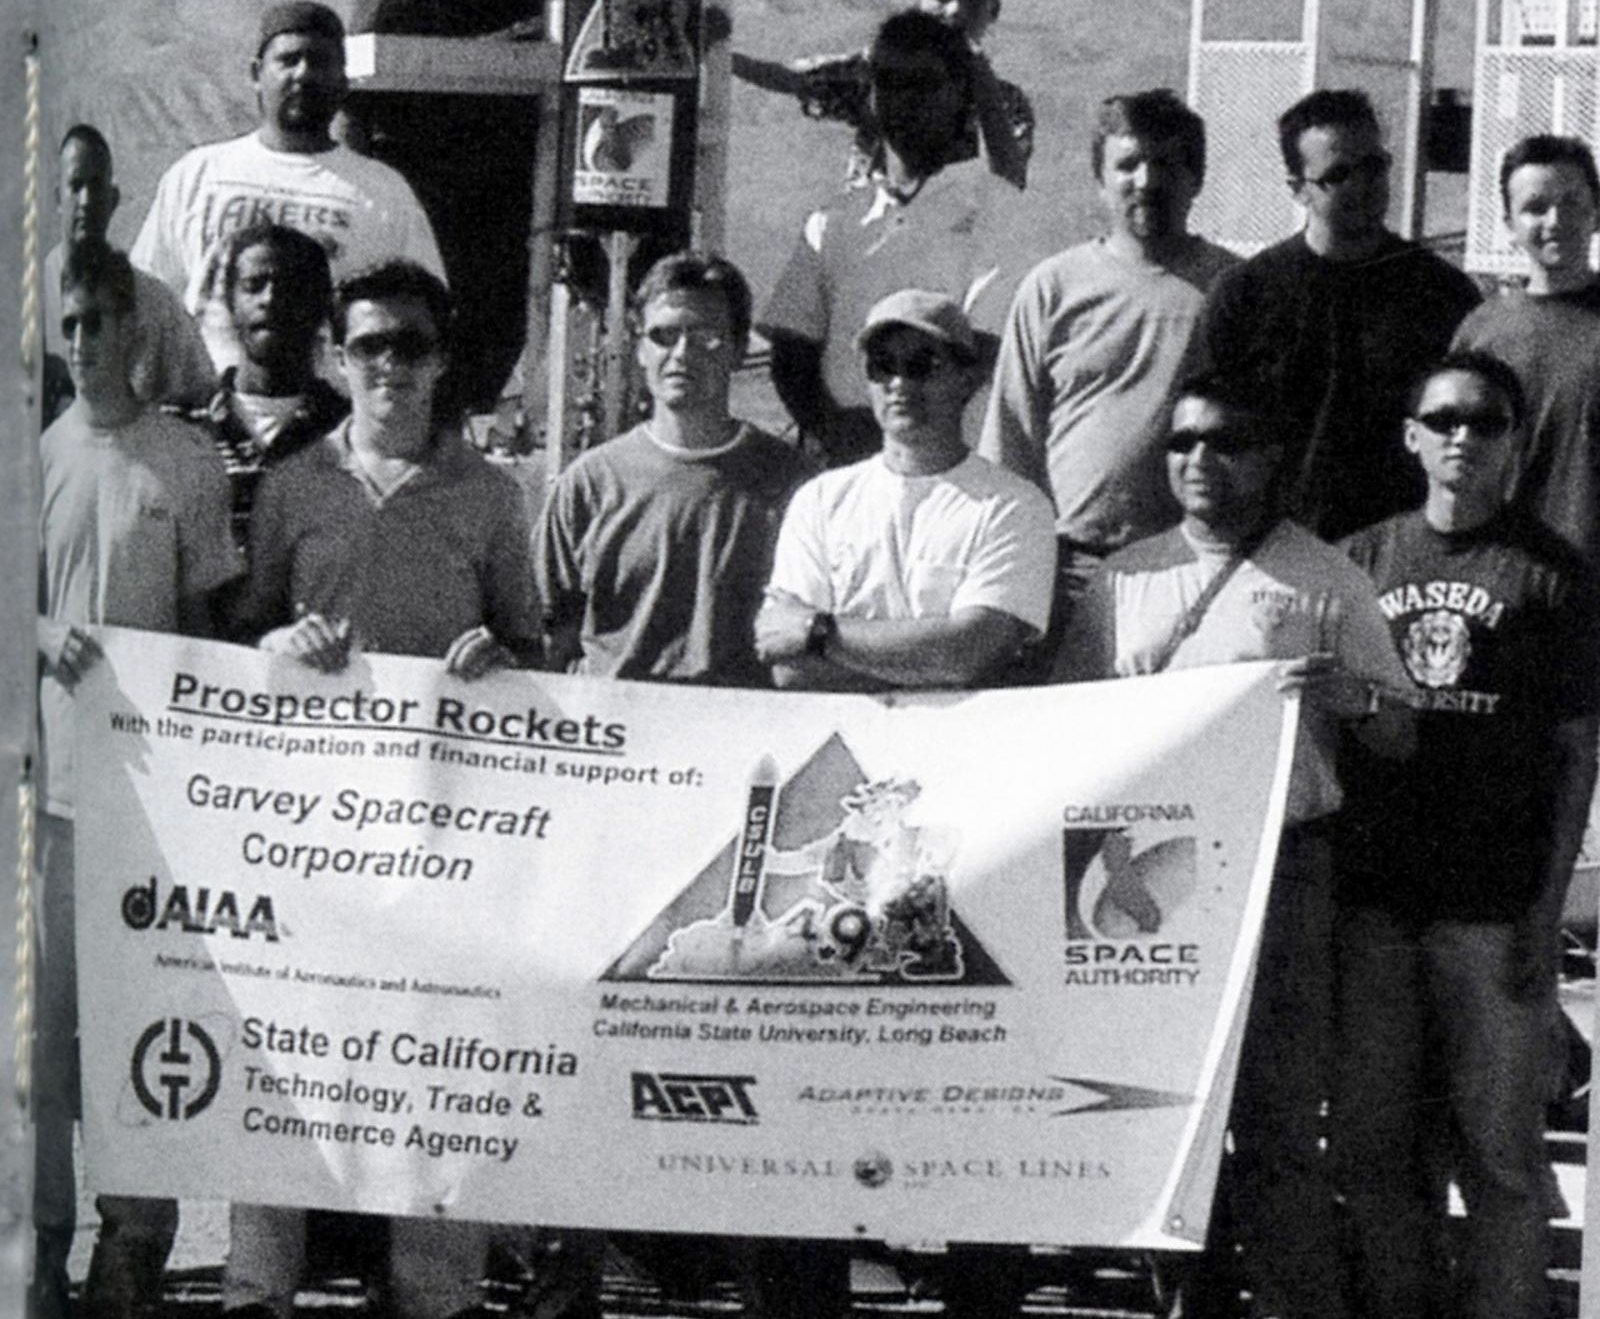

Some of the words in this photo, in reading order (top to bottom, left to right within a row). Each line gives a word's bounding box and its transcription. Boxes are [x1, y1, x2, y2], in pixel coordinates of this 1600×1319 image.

[1377, 580, 1504, 629] WASEDA
[169, 671, 418, 724] Prospector
[435, 696, 627, 749] Rockets
[109, 711, 151, 734] With
[157, 718, 194, 740] the
[201, 728, 365, 757] participation
[373, 739, 420, 758] and
[428, 740, 546, 774] financial
[554, 760, 659, 786] support
[668, 766, 704, 787] of:
[187, 773, 321, 824] Garvey
[331, 788, 552, 839] Spacecraft
[1063, 803, 1196, 824] CALIFORNIA
[242, 832, 474, 881] Corporation
[1064, 943, 1200, 965] SPACE
[1065, 967, 1201, 987] AUTHORITY
[601, 993, 719, 1013] Mechanical
[726, 997, 739, 1014] &
[747, 997, 861, 1018] Aerospace
[866, 998, 997, 1020] Engineering
[241, 1017, 330, 1057] State
[341, 1030, 382, 1062] of
[390, 1032, 579, 1076] California
[593, 1019, 691, 1040] California
[698, 1022, 753, 1041] State
[878, 1025, 933, 1046] Long
[939, 1025, 1007, 1043] Beach
[244, 1066, 414, 1114] Technology,
[426, 1085, 512, 1116] Trade
[522, 1092, 543, 1118] &
[243, 1106, 396, 1147] Commerce
[405, 1124, 519, 1162] Agency
[658, 1154, 838, 1177] UNIVERSAL
[904, 1158, 1003, 1178] SPACE
[1019, 1158, 1111, 1179] LINES
